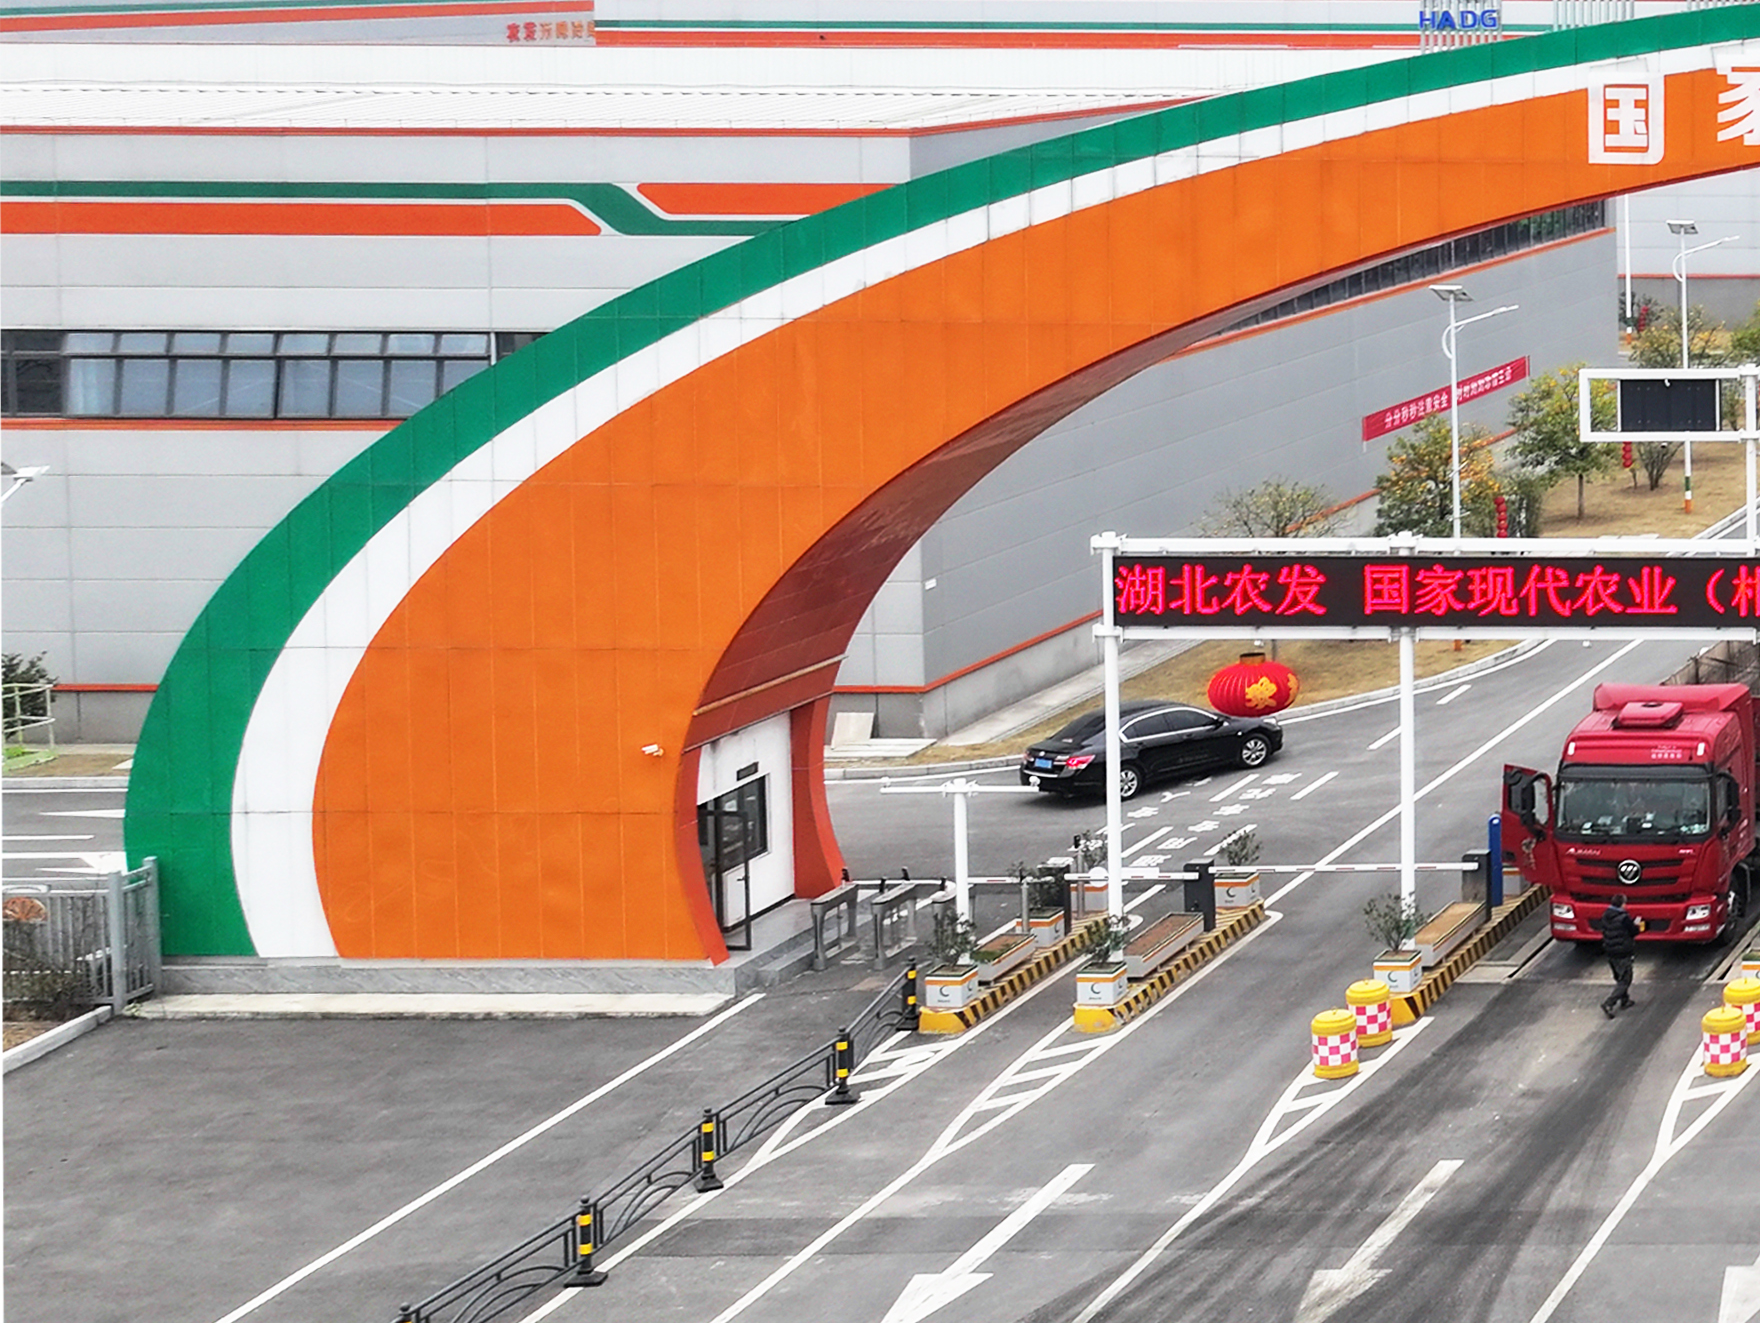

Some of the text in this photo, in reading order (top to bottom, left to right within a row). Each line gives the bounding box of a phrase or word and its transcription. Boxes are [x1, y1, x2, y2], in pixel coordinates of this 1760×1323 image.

[1419, 9, 1498, 31] HADG
[1115, 563, 1326, 616] 湖北农发
